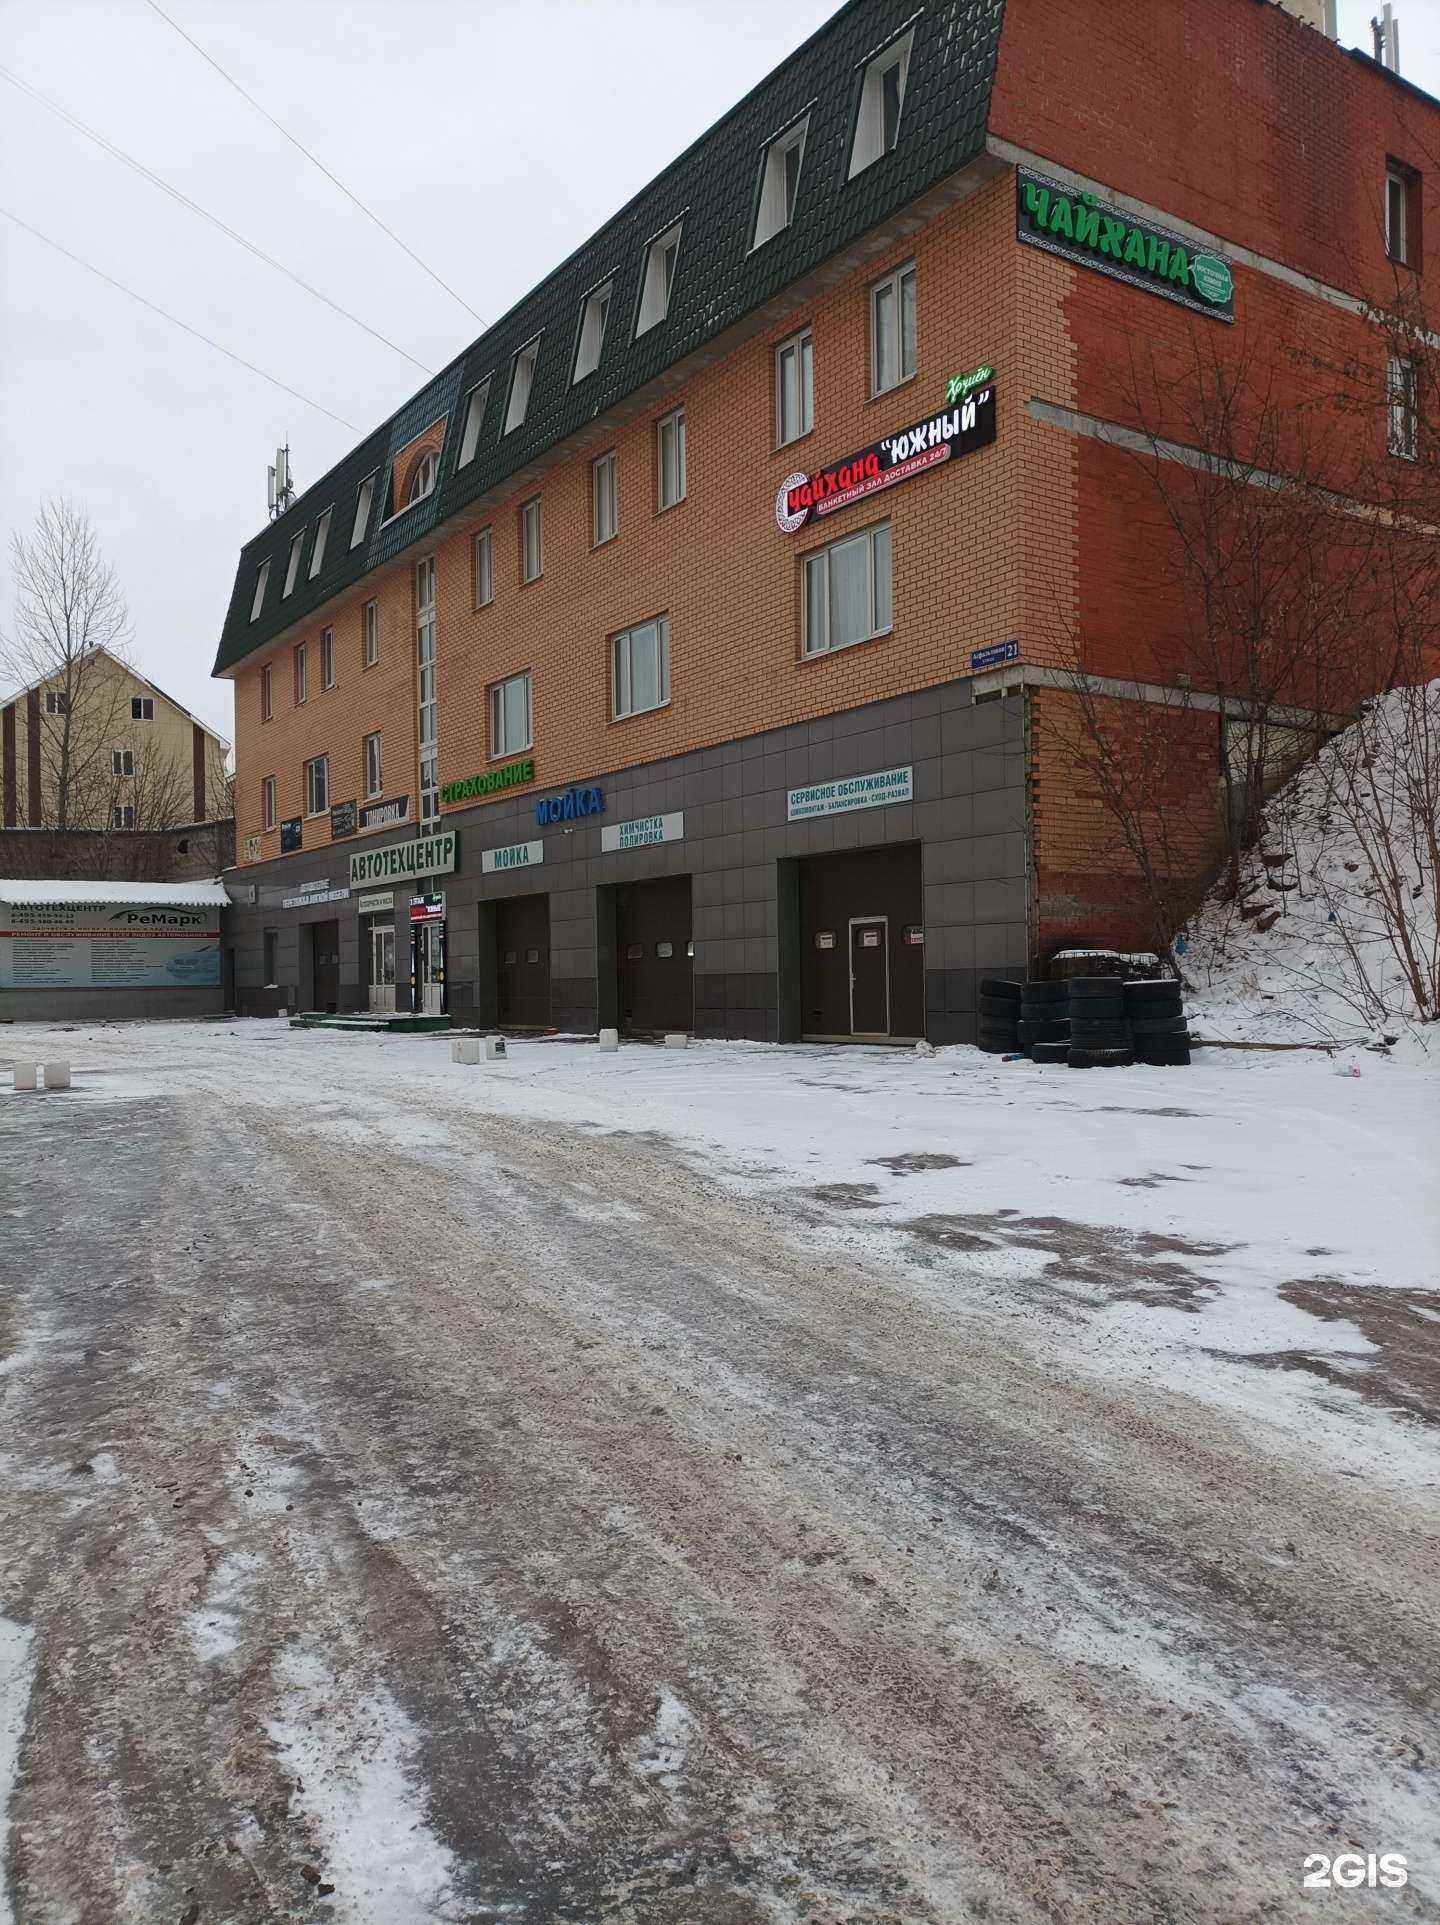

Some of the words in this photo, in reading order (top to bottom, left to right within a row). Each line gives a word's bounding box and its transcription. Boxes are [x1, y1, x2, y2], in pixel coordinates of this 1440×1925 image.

[1022, 183, 1189, 285] ЧАЙХАНА
[818, 485, 865, 511] БАНКЕТНЫЙ
[866, 479, 883, 491] ЗАЛ
[884, 458, 928, 482] ДОСТАВКА
[929, 447, 947, 461] 24/7
[1007, 643, 1018, 656] 21
[442, 759, 533, 801] СТРАХОВАНИЕ
[791, 786, 836, 805] СЕРВИСНОЕ
[838, 771, 908, 796] ОБСЛУЖИВАНИЕ
[536, 787, 605, 825] МОЙКА
[828, 796, 868, 809] БАЛАНСИРОВКА
[871, 788, 909, 802] СХОД-РАЗВАЛ
[365, 803, 400, 826] ТОНИРОВКА
[619, 817, 663, 836] ХИМЧИСТКА
[619, 830, 663, 848] ПОЛИРОВКА
[351, 838, 453, 881] АВТОТЕХЦЕНТР
[495, 846, 529, 869] МОЙКА
[127, 913, 202, 926] РеМарк
